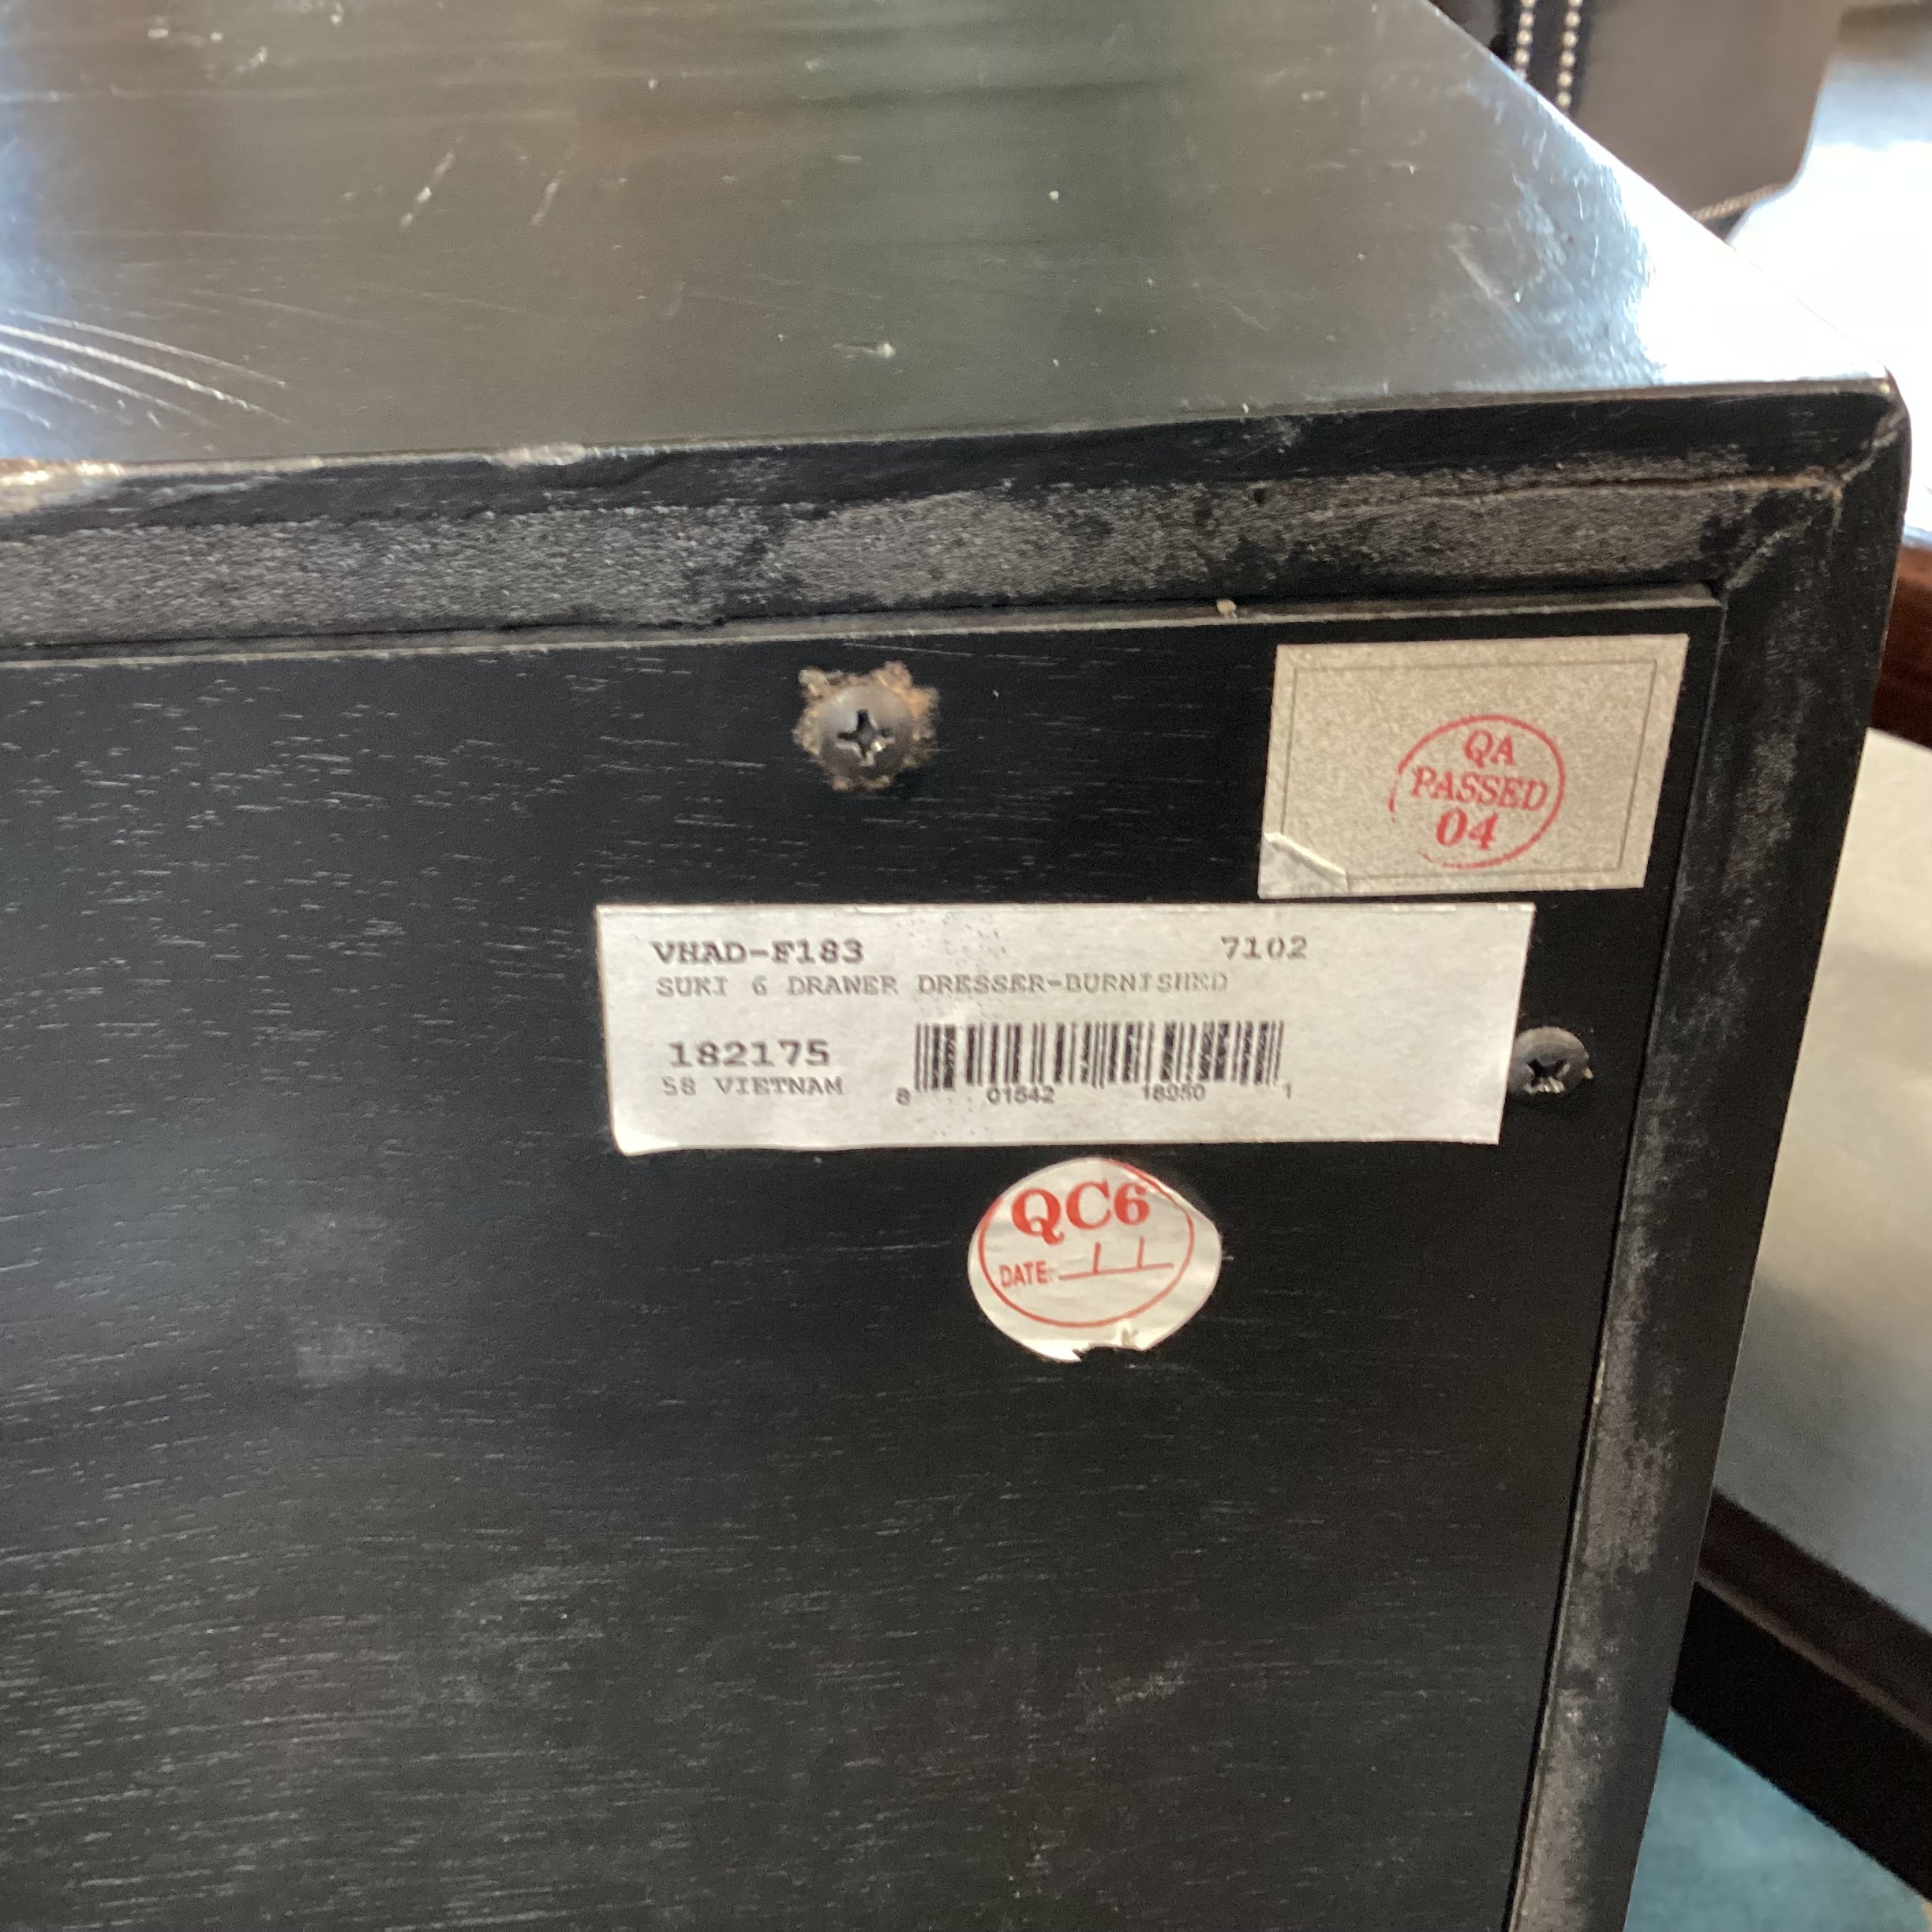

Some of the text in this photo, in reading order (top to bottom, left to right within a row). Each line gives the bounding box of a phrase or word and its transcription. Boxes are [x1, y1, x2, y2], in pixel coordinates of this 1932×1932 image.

[1463, 729, 1515, 767] QA
[1410, 765, 1548, 812] PASSED
[1435, 807, 1500, 850] 04
[650, 937, 865, 964] VHAD-F183
[1220, 934, 1308, 960] 7102
[655, 976, 728, 998] SUKI
[751, 975, 769, 997] 6
[788, 974, 899, 996] DRAWER
[668, 1039, 830, 1068] 182175
[715, 1076, 844, 1095] VIETNAM
[896, 1087, 911, 1105] 8
[987, 1084, 1056, 1105] 01542
[1010, 1181, 1151, 1246] QC6
